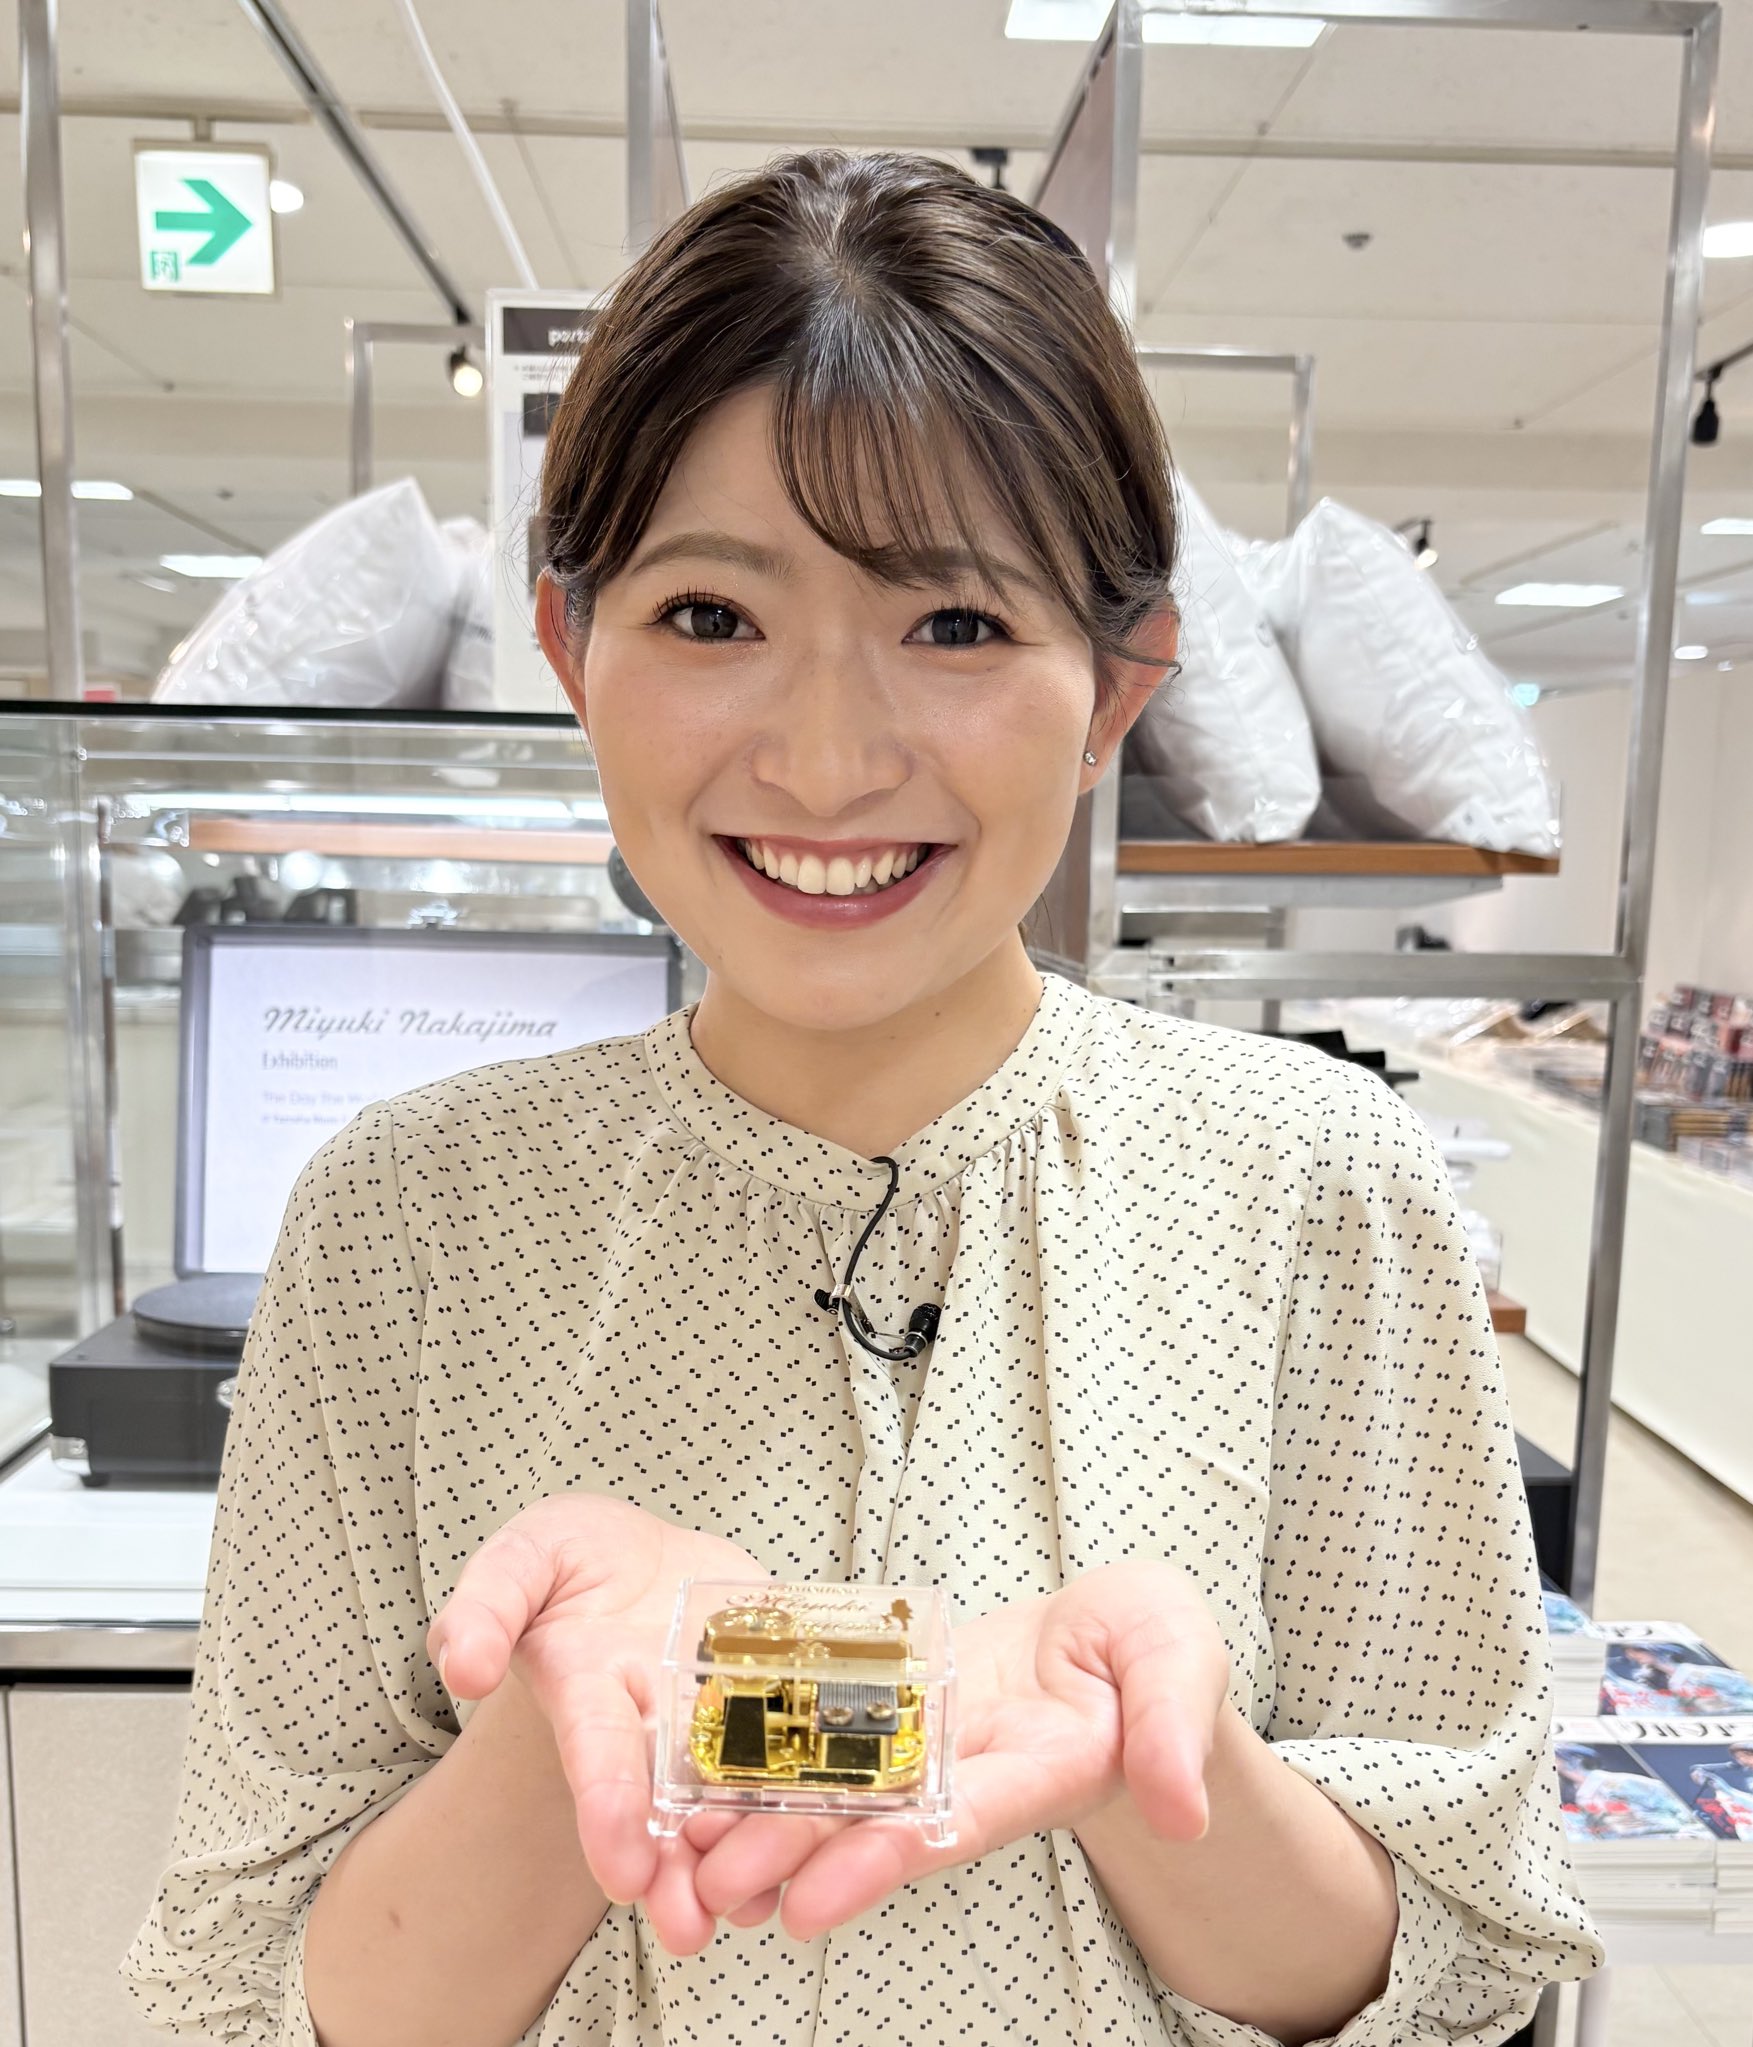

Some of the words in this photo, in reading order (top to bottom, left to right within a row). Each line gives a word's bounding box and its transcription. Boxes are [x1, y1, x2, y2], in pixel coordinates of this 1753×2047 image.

[264, 1006, 390, 1040] Miyuki
[399, 1008, 557, 1042] Nakajima
[262, 1050, 338, 1070] Exhibition
